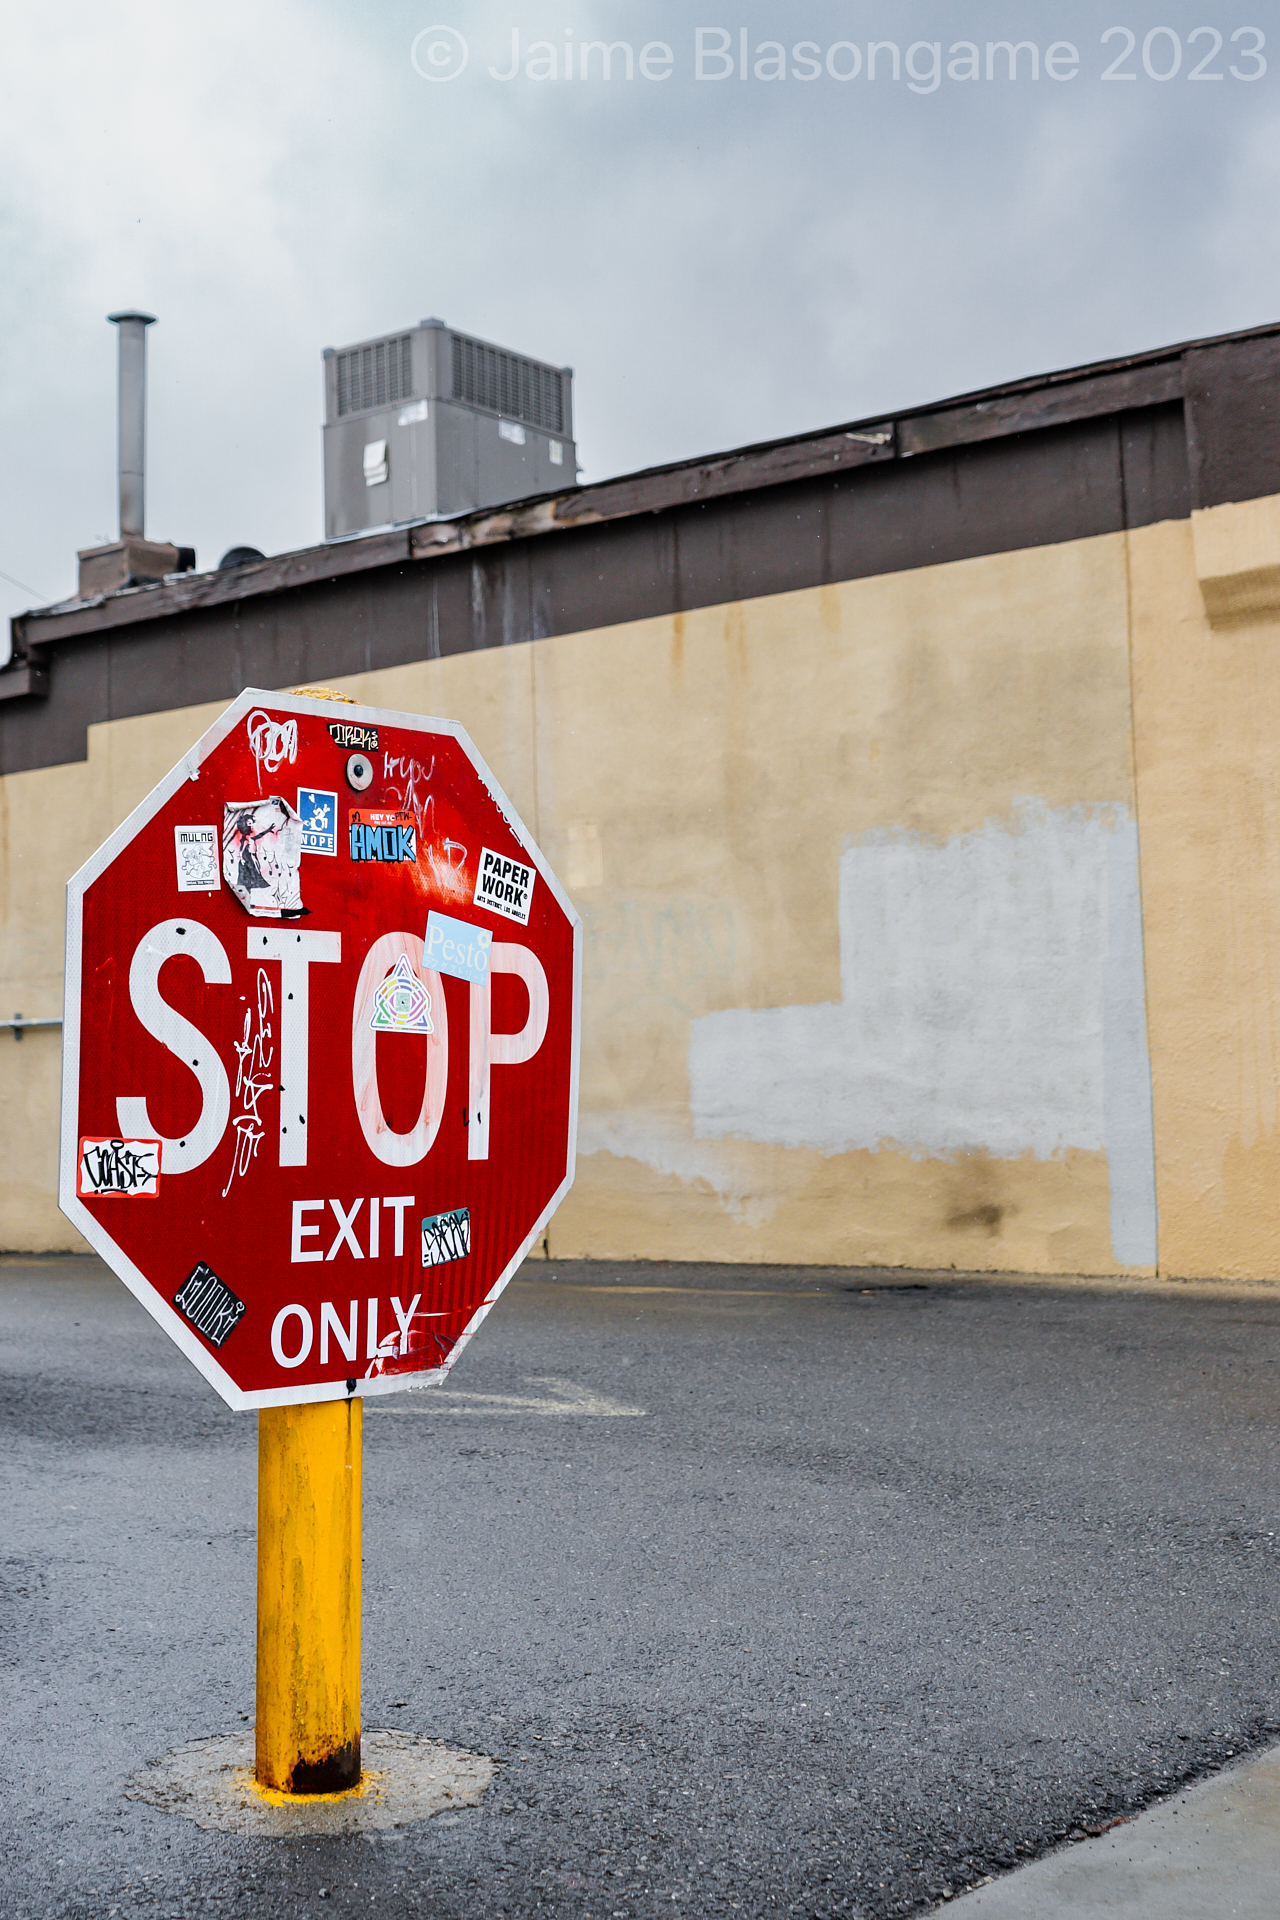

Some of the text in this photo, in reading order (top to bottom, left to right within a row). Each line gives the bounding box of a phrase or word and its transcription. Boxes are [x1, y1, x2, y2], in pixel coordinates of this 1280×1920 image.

[301, 834, 333, 848] NOPE
[350, 823, 416, 864] AMOK
[484, 853, 529, 888] PAPER
[425, 924, 488, 972] Pesto
[116, 918, 549, 1174] STOP
[291, 1196, 415, 1263] EXIT
[271, 1293, 421, 1369] ONLY
